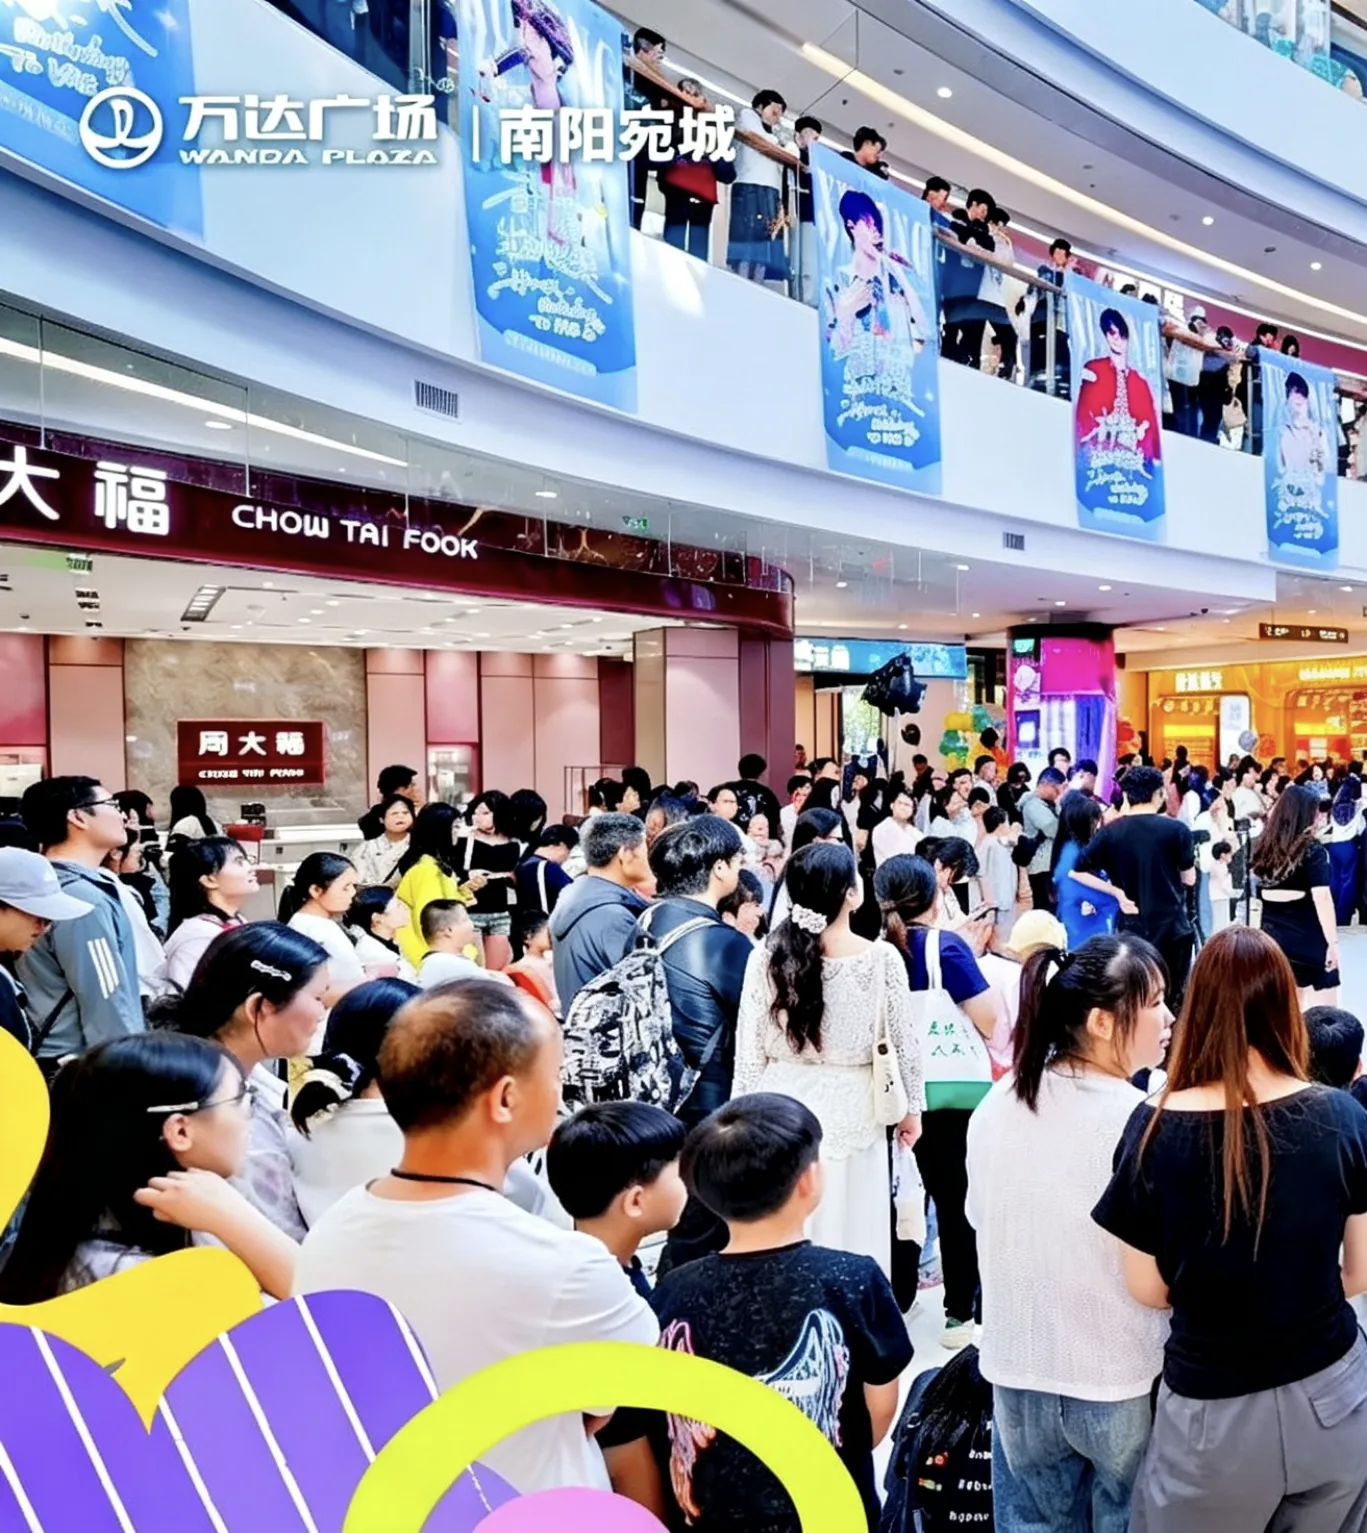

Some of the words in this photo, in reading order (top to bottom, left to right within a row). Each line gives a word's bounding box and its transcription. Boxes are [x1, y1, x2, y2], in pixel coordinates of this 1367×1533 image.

[231, 504, 329, 539] CHOW
[339, 519, 389, 548] TAI
[403, 528, 478, 560] FOOK
